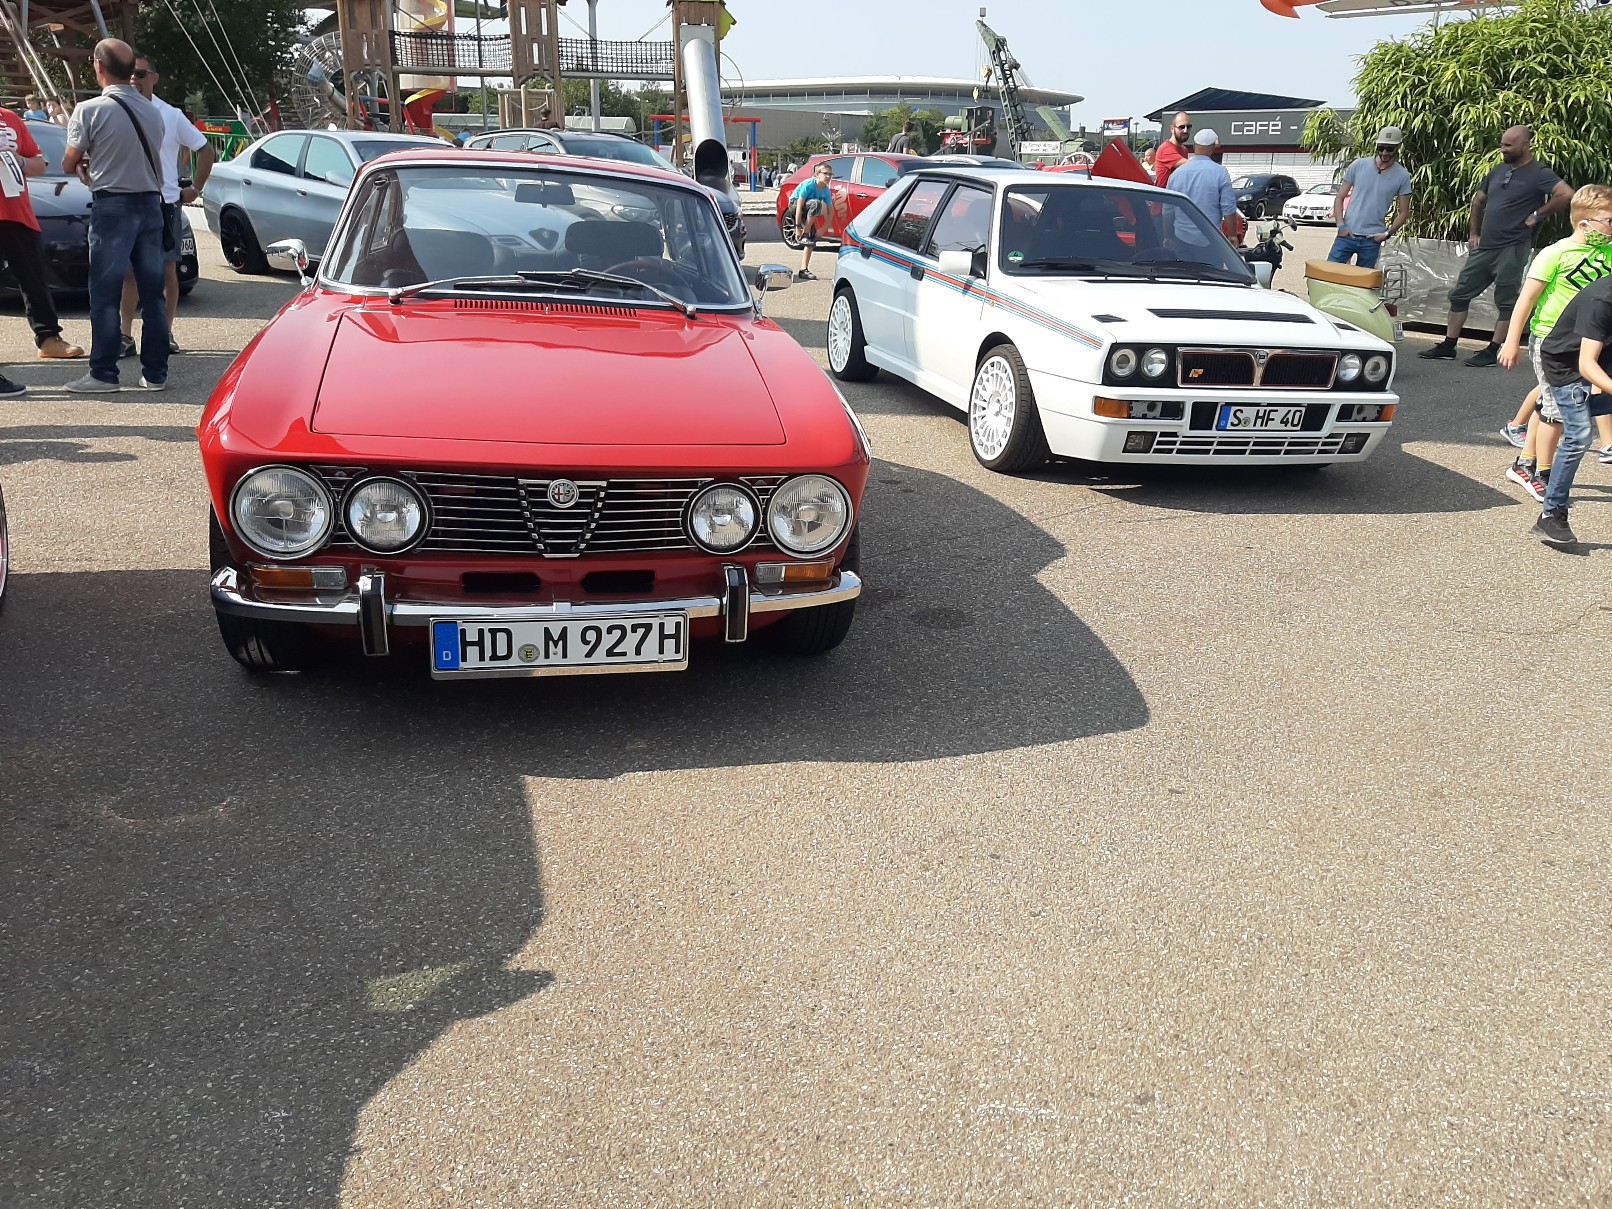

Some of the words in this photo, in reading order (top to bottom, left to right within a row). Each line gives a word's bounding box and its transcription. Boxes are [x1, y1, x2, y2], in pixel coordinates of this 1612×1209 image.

[1230, 408, 1244, 427] S
[1253, 409, 1279, 427] HF
[1279, 409, 1304, 427] 40
[459, 627, 514, 663] HD
[543, 626, 568, 659] M
[580, 621, 682, 659] 927H
[442, 651, 452, 661] D
